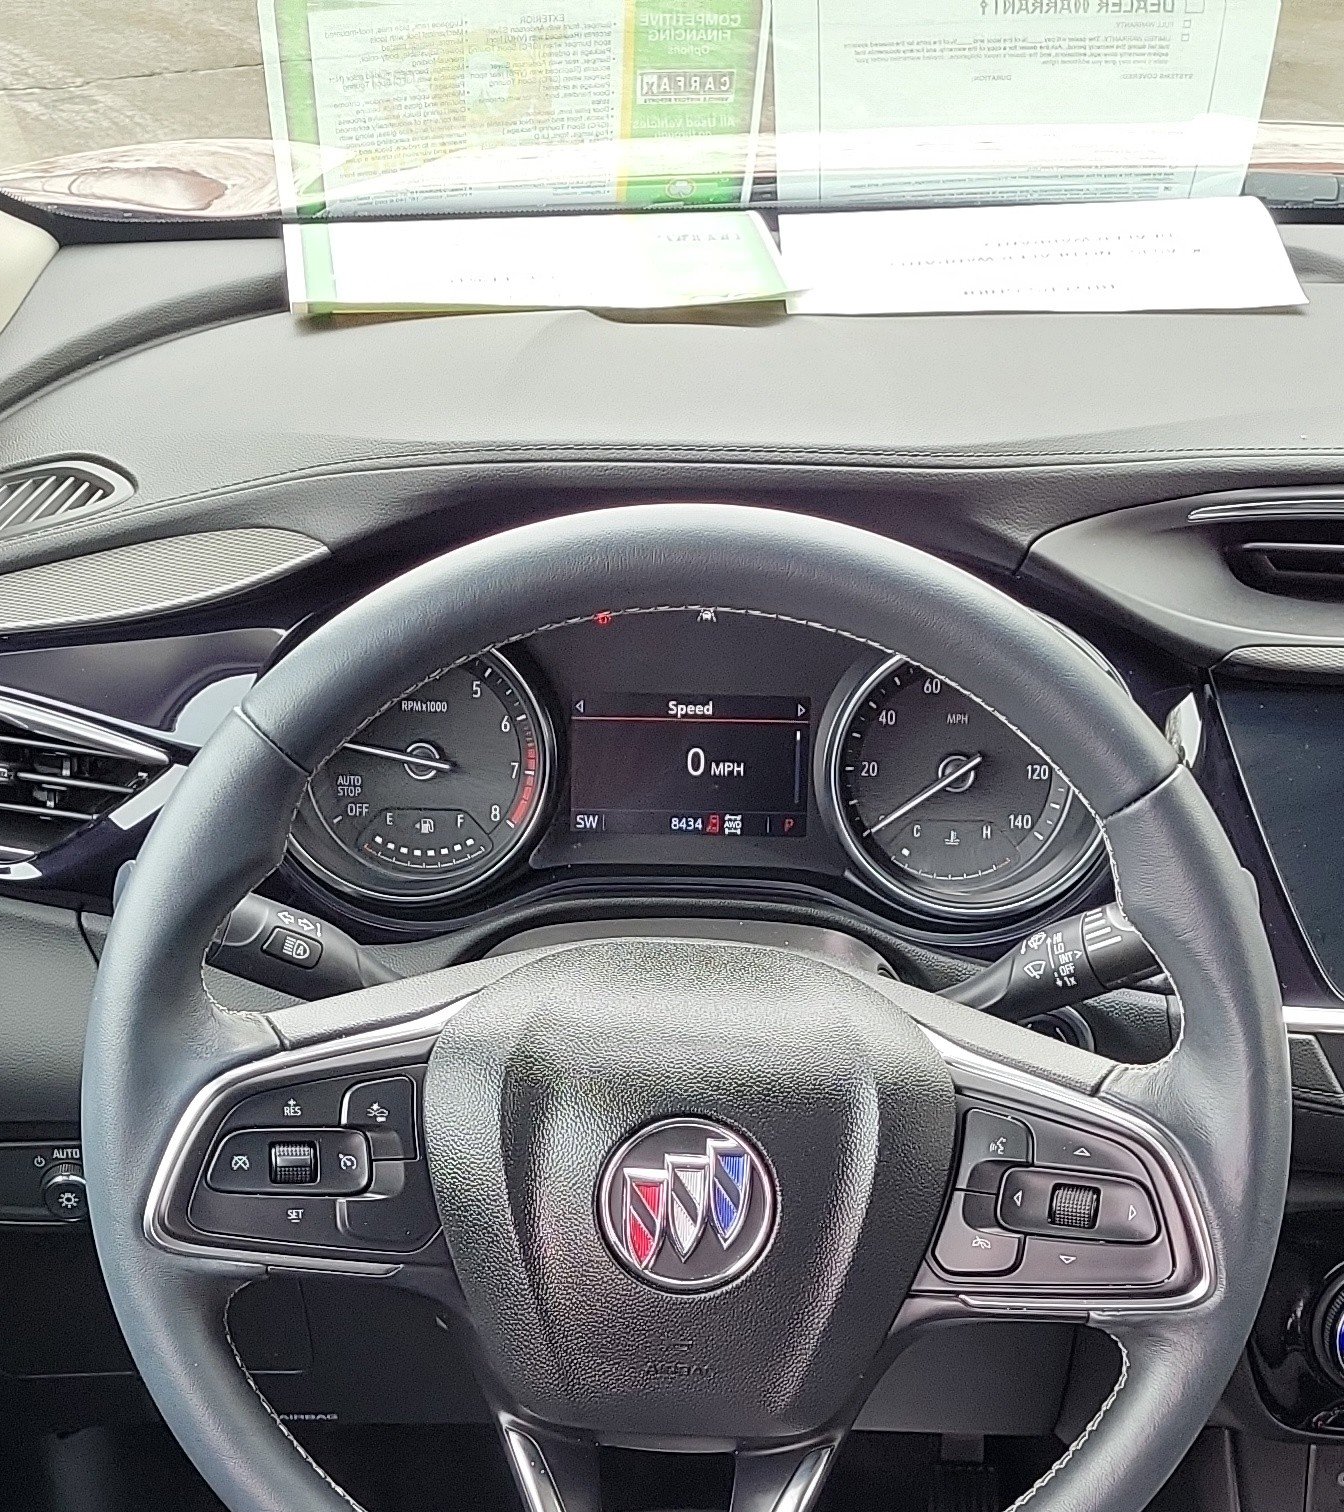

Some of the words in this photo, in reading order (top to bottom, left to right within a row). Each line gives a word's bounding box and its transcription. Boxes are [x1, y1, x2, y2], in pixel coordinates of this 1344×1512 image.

[472, 681, 481, 698] 5
[923, 679, 941, 694] 60
[401, 700, 447, 712] RPMx1000
[668, 701, 713, 718] Speed
[501, 716, 510, 732] 6
[878, 710, 896, 726] 40
[947, 714, 969, 725] MPH
[687, 747, 705, 776] 0
[711, 762, 745, 777] MPH
[510, 762, 519, 779] 7
[861, 762, 878, 777] 20
[1026, 765, 1049, 780] 120
[337, 775, 362, 786] AUTO
[337, 786, 362, 797] STOP
[347, 804, 369, 817] OFF
[490, 804, 500, 821] 8
[386, 813, 394, 826] E
[456, 814, 465, 828] F
[575, 814, 599, 829] SW
[671, 817, 703, 831] 8434
[723, 819, 742, 830] AWD
[1008, 814, 1032, 829] 140
[913, 824, 922, 838] C
[982, 825, 991, 839] H
[1053, 943, 1064, 955] LO
[1058, 950, 1074, 965] INT
[1059, 963, 1076, 976] OFF
[284, 1106, 302, 1117] RES
[53, 1148, 80, 1159] AUTO
[287, 1209, 304, 1220] SET
